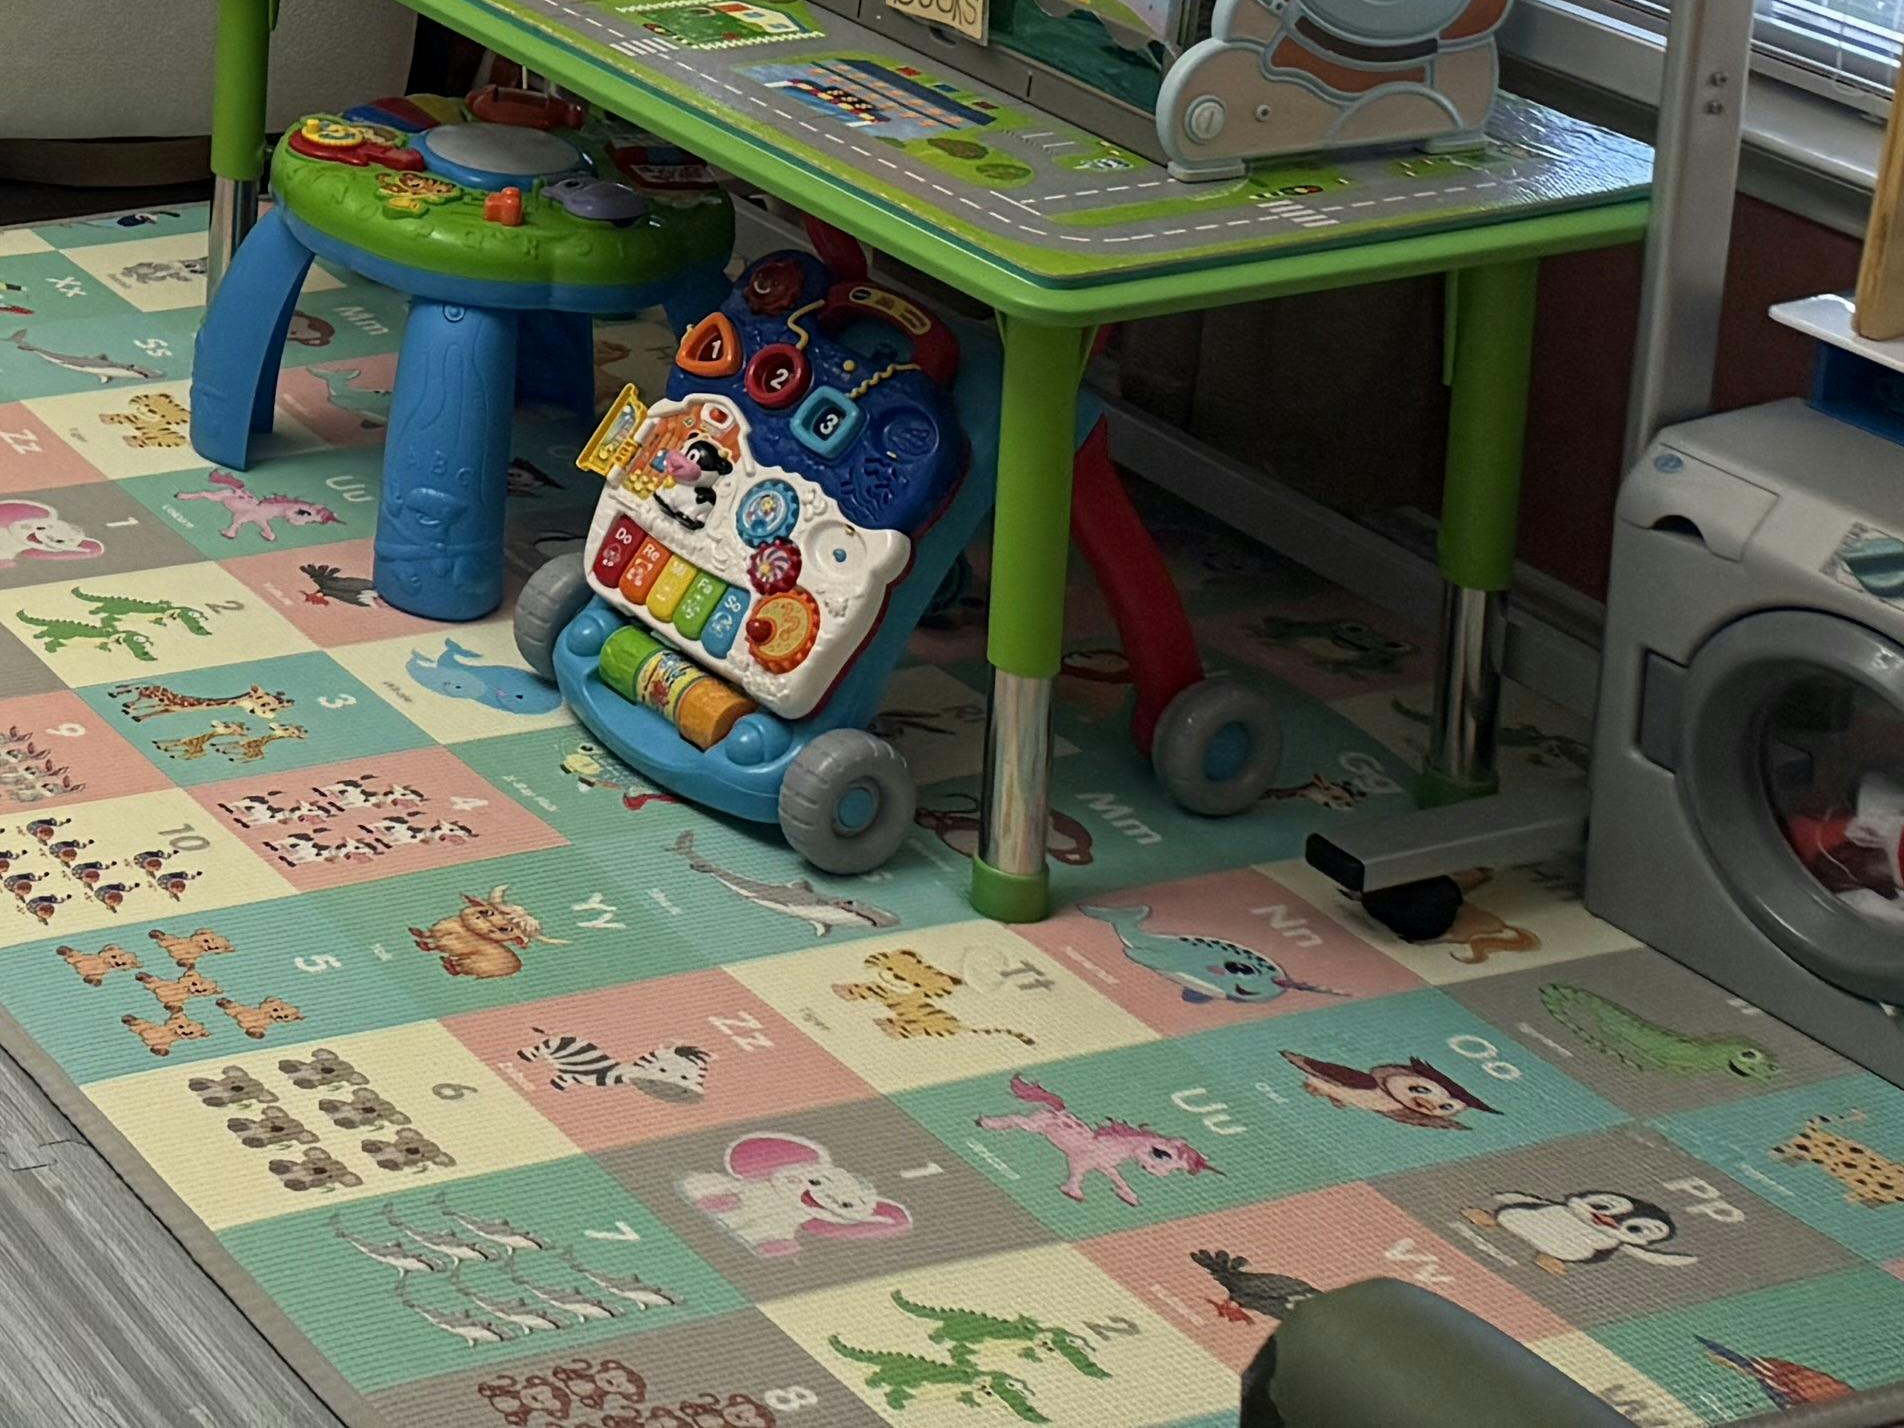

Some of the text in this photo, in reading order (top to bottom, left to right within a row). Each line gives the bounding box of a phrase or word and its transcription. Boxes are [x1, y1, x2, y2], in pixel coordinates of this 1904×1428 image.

[711, 340, 721, 359] 1
[771, 369, 789, 388] 2
[820, 414, 838, 434] 3
